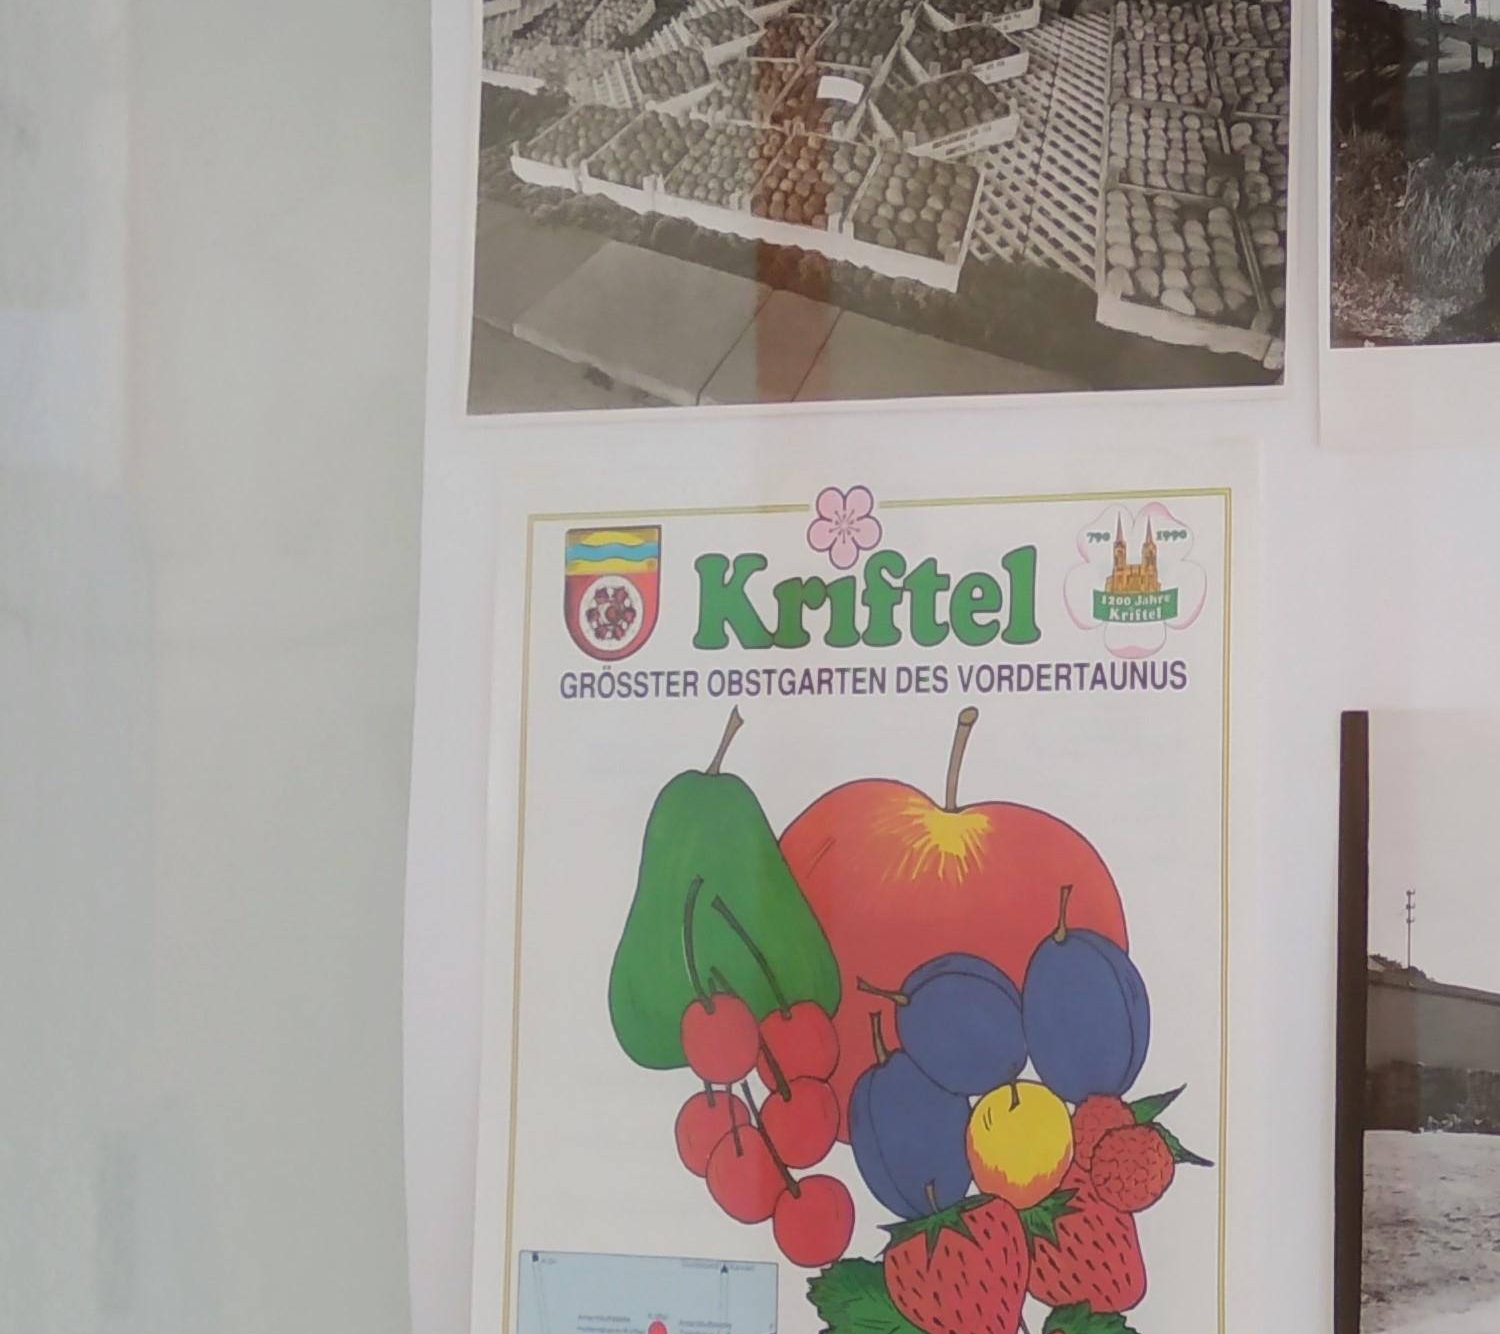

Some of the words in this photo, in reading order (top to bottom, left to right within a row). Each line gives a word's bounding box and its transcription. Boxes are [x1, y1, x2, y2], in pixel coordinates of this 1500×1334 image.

[1156, 529, 1188, 542] 1990
[692, 544, 1042, 650] Kriftel
[1101, 594, 1132, 606] 1200
[1134, 592, 1171, 606] Jahre
[1109, 607, 1162, 622] Kriftel
[559, 664, 699, 699] GRÖSSTER
[706, 666, 887, 697] OBSTGARTEN
[895, 665, 949, 694] DES
[956, 660, 1188, 693] VORDERTAUNUS
